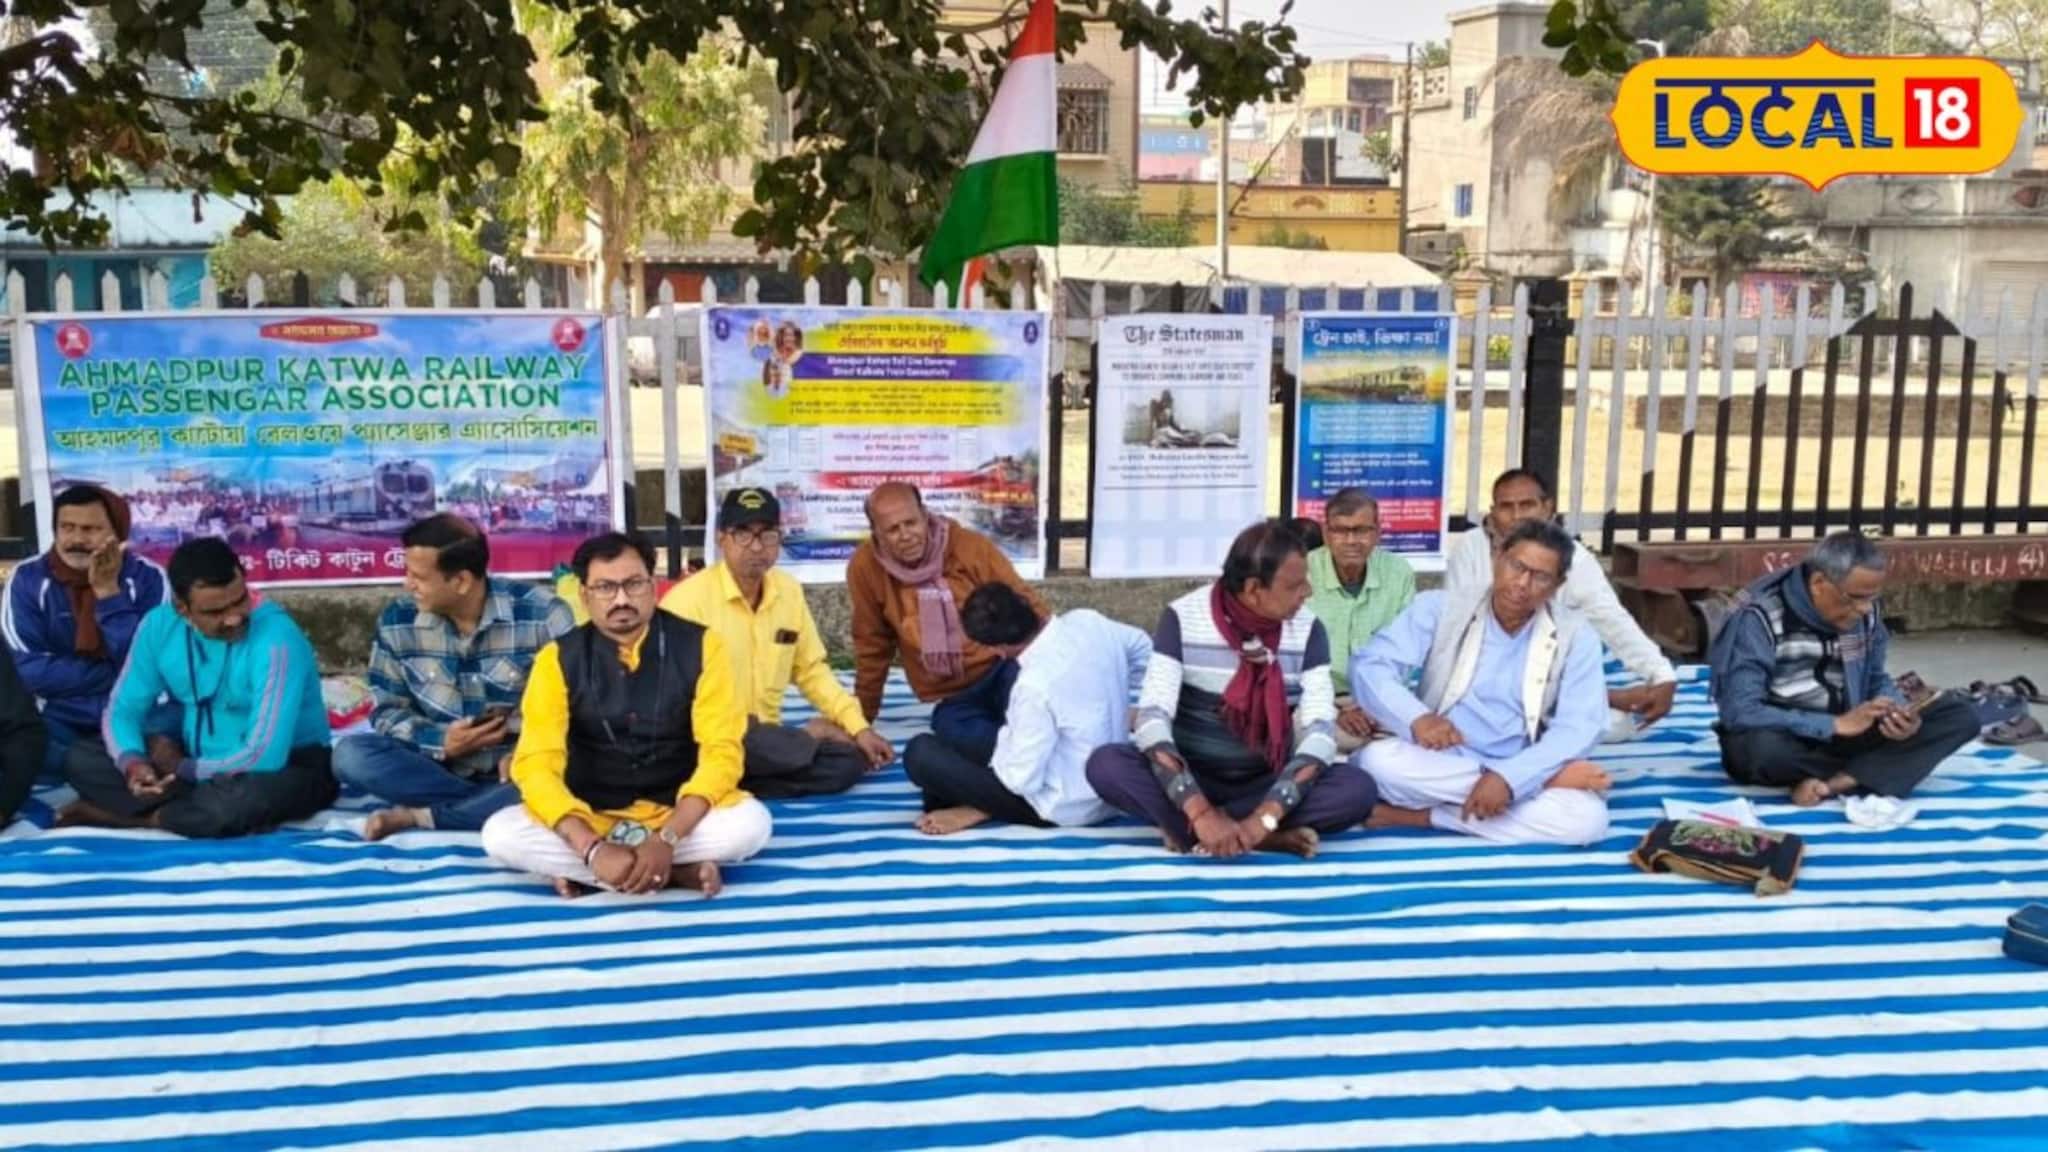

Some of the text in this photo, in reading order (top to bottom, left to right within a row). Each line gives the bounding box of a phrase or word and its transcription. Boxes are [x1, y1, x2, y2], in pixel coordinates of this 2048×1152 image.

[1123, 324, 1244, 345] The Statesman
[59, 355, 586, 389] AHMADPUR KATWA RAILWAY
[91, 383, 560, 416] PASSENGAR ASSOCIATION
[266, 548, 321, 571] টিকিট
[327, 547, 375, 573] কাটুন
